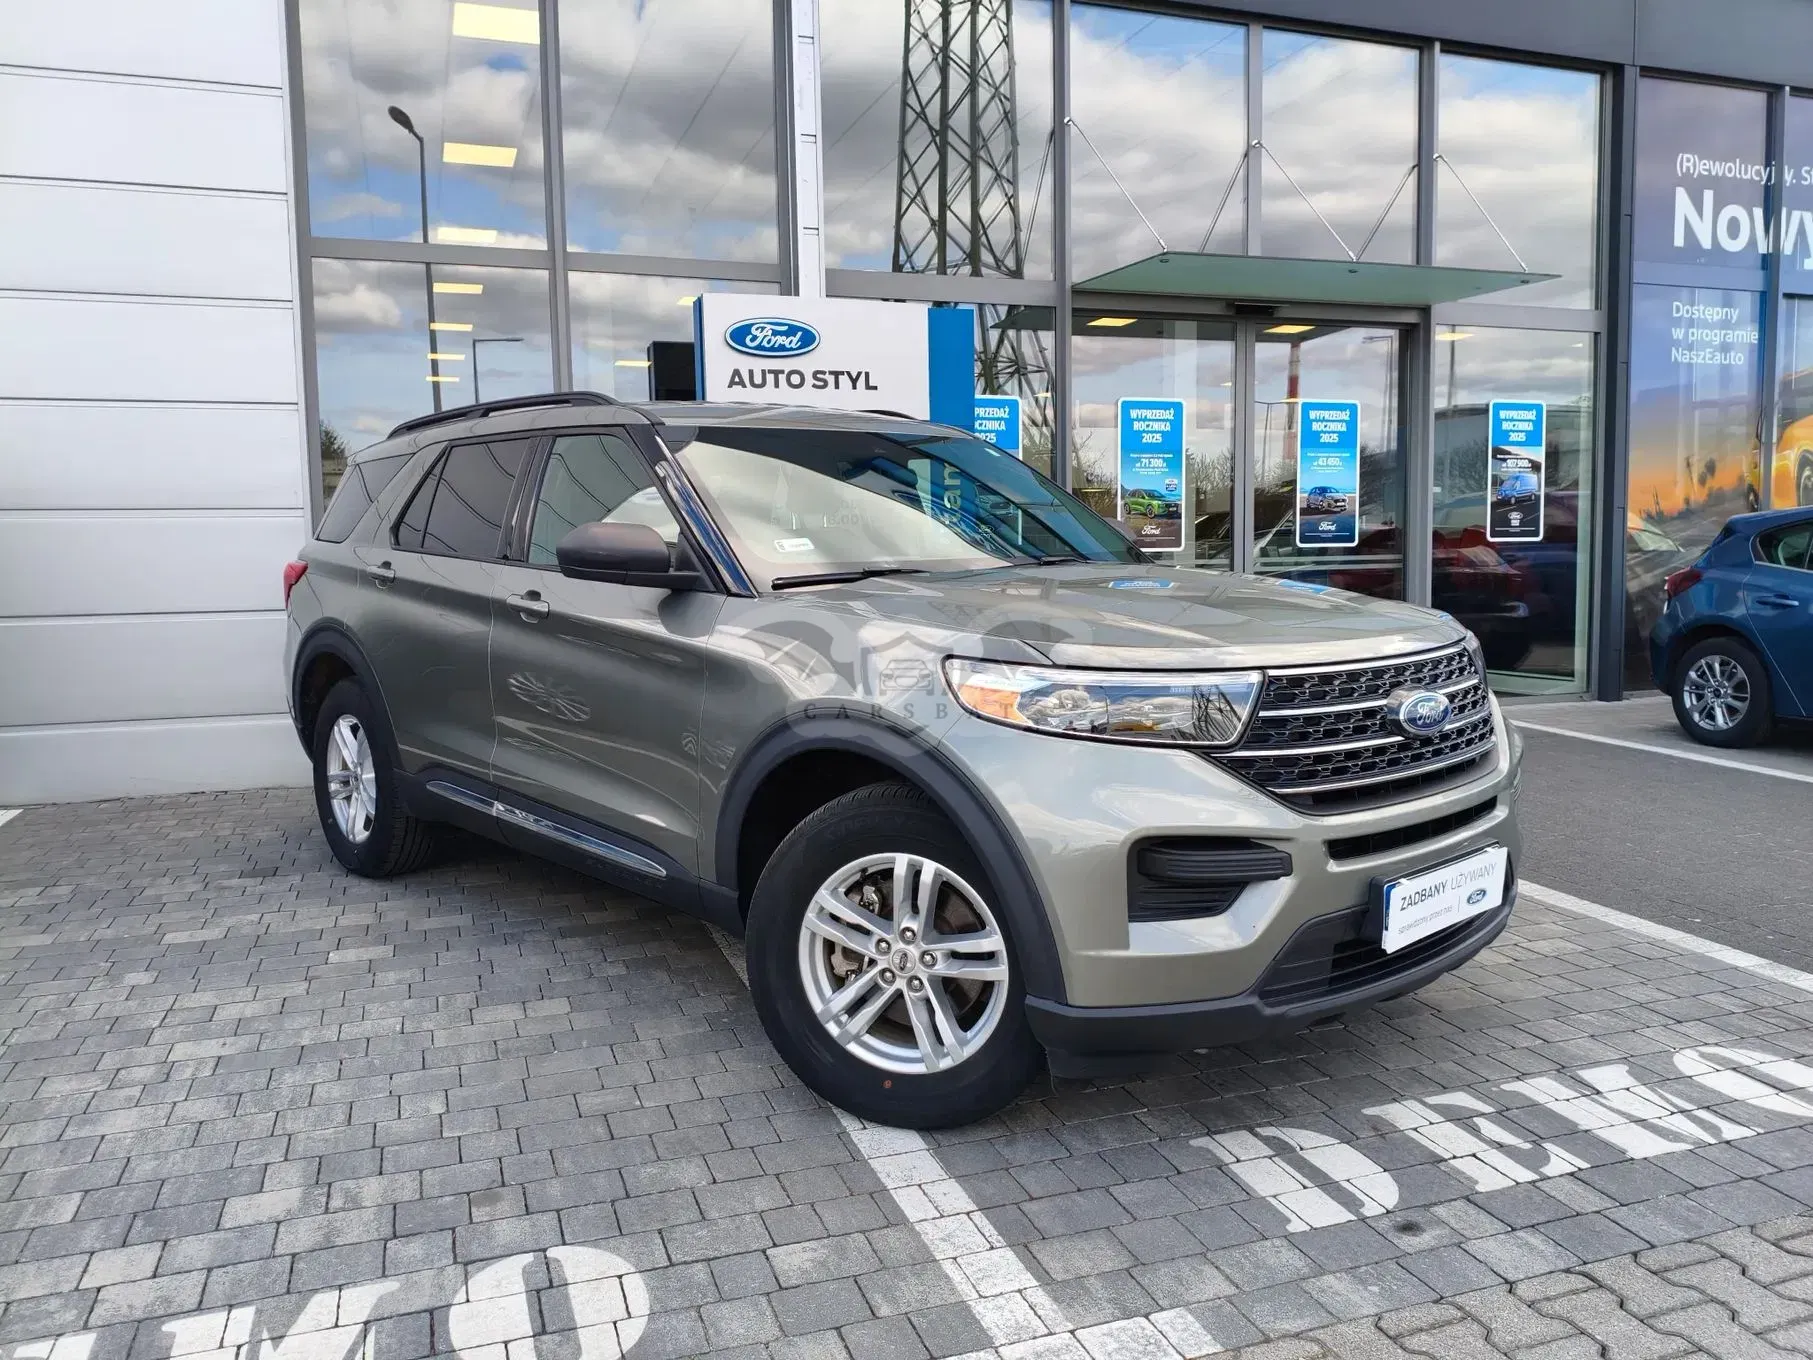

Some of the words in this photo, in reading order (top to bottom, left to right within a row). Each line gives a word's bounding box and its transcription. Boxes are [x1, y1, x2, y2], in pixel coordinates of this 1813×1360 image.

[1676, 153, 1796, 187] (R)ewolucyjy.
[1672, 301, 1739, 323] Dostępny
[746, 324, 802, 349] Ford
[1672, 328, 1684, 340] w
[1688, 327, 1759, 345] programie
[1671, 347, 1744, 366] NaszEauto
[727, 368, 806, 390] AUTO
[811, 369, 878, 391] STYL
[975, 405, 1009, 418] PRZEDAŻ
[1130, 407, 1174, 420] WYPRZEDAŻ
[1309, 409, 1350, 420] WYPRZEDAŻ
[1499, 409, 1537, 420] WYPRZEDAŻ
[975, 420, 1006, 431] CZNIKA
[1133, 421, 1171, 432] ROCZNIKA
[1312, 421, 1346, 432] ROCZNIKA
[1502, 421, 1533, 431] ROCZNIKA
[1142, 433, 1162, 443] 2025
[1320, 433, 1339, 443] 2025
[1508, 432, 1526, 442] 2025
[1142, 525, 1161, 535] Ford
[1319, 521, 1337, 531] Ford
[1416, 701, 1444, 725] Ford
[1400, 880, 1448, 912] ZADBANY
[1450, 862, 1498, 891] UŻYWANY
[1190, 1046, 1813, 1232] DEMO
